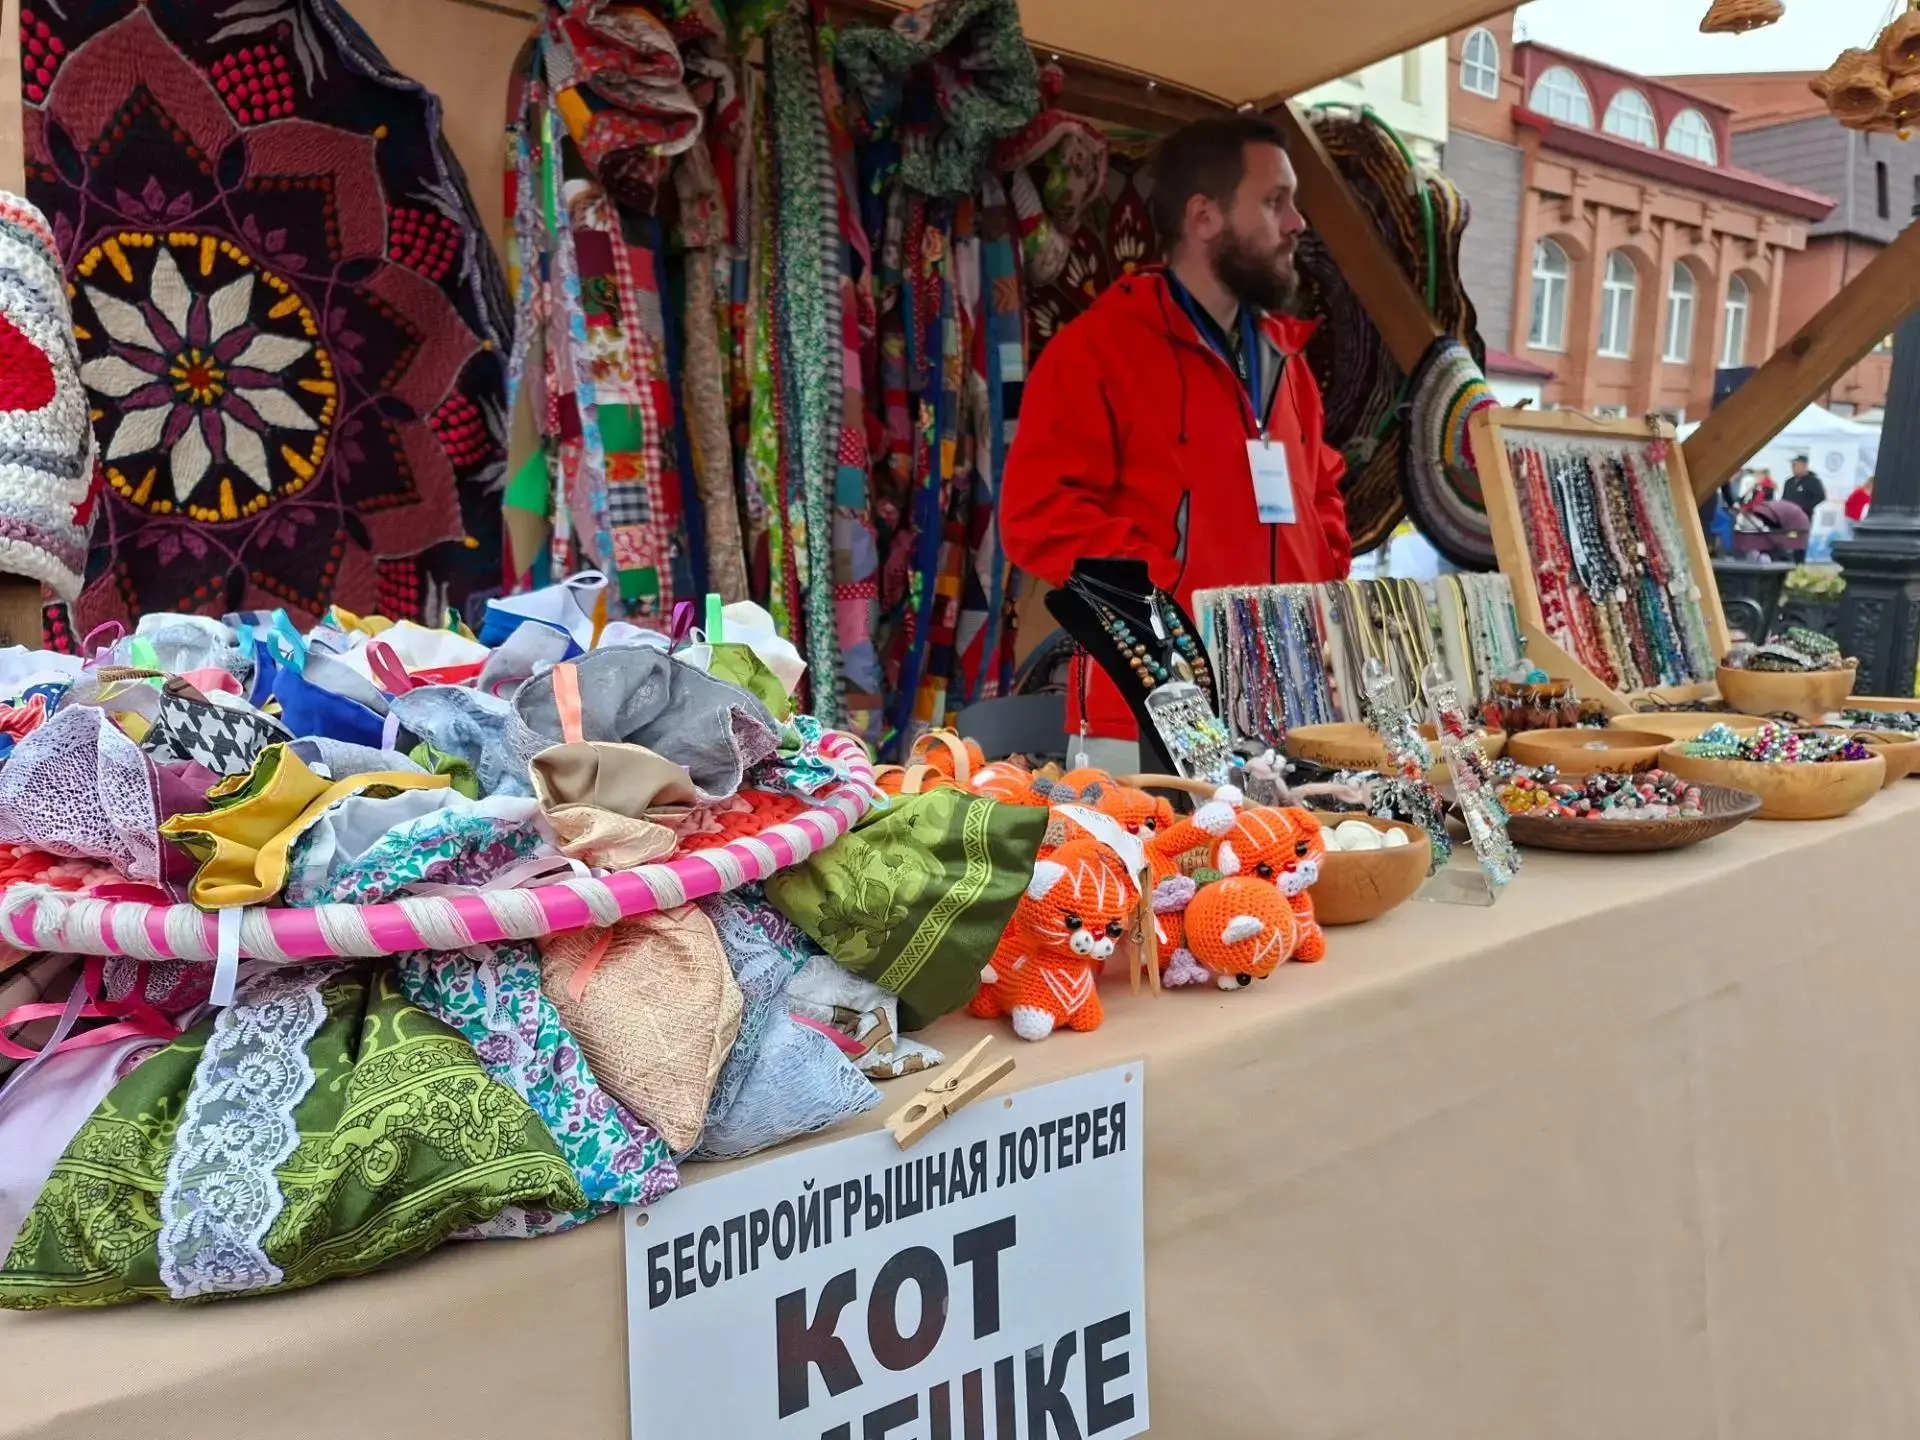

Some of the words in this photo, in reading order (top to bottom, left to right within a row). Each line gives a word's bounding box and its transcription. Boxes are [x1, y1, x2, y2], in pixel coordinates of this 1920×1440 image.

[648, 1140, 988, 1309] БЕСПРОЙГРЫШНАЯ
[997, 1102, 1127, 1188] ЛОТЕРЕЯ
[776, 1215, 1017, 1419] КОТ
[820, 1311, 1136, 1440] ШКЕ
